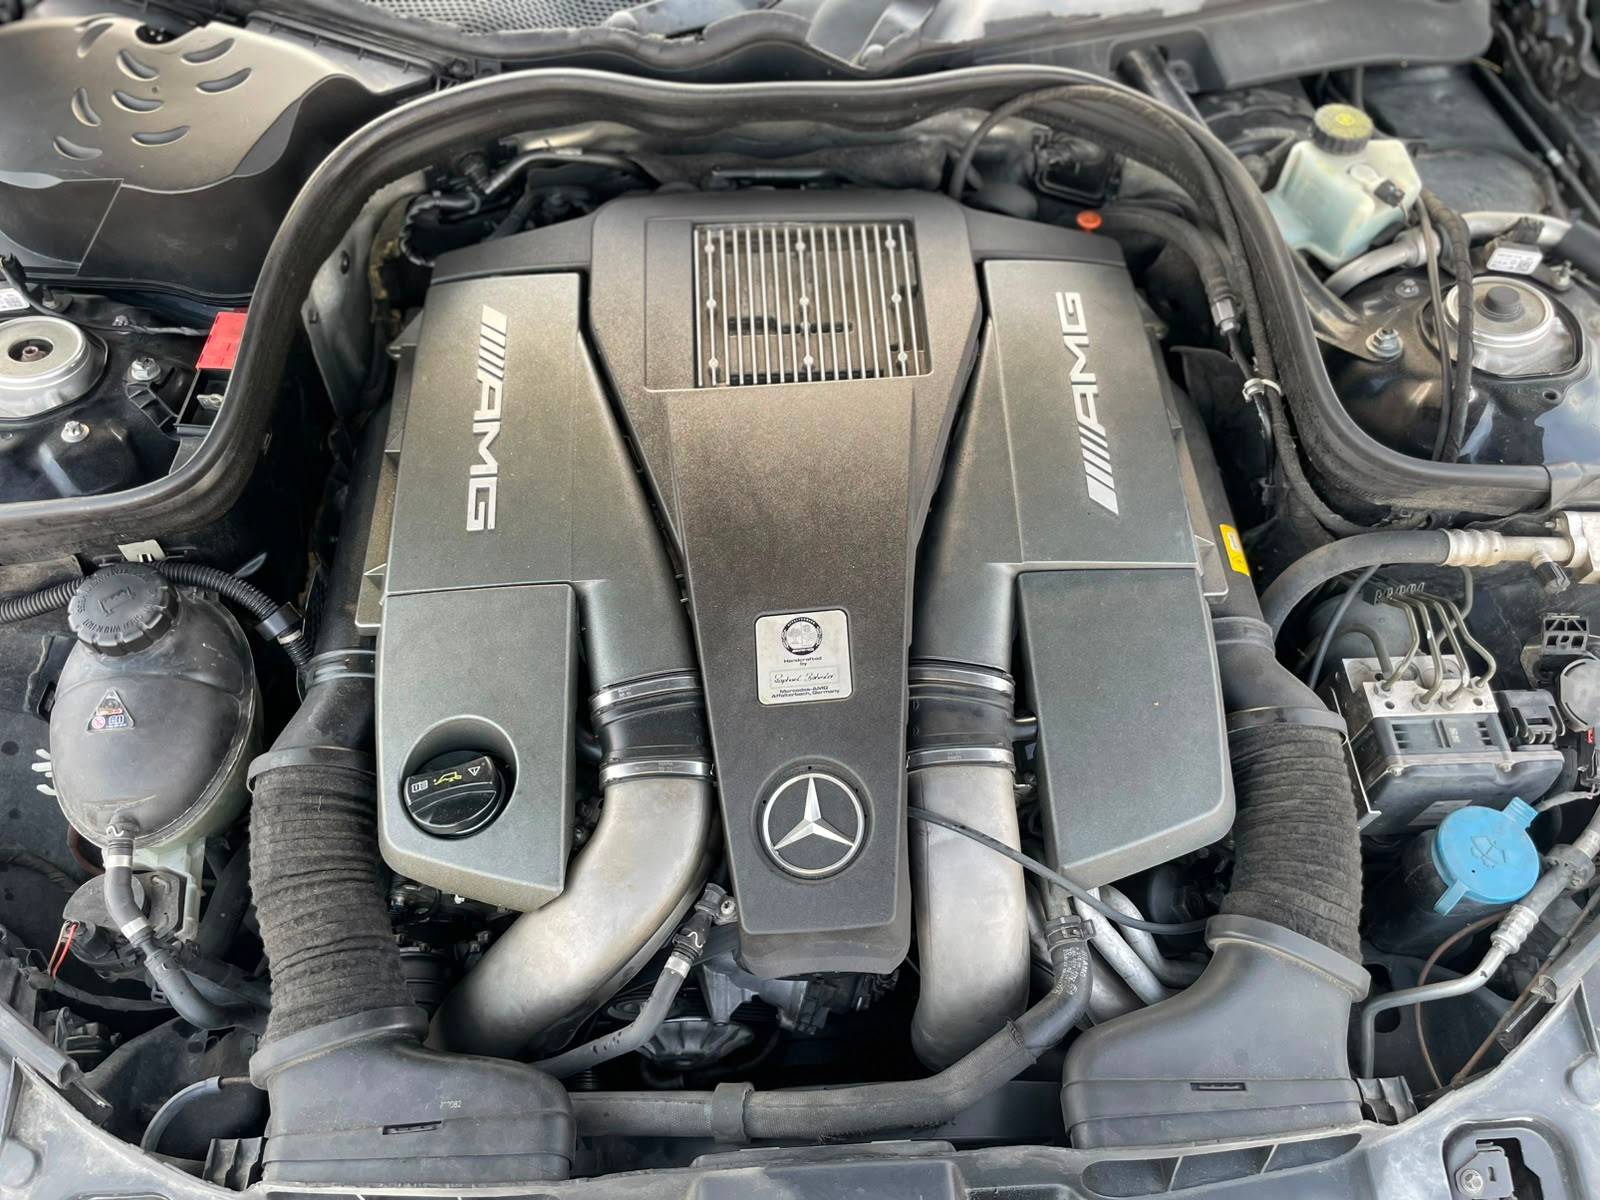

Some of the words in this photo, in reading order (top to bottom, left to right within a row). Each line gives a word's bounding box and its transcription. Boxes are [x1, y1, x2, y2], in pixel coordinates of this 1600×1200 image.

[1056, 291, 1106, 437] AMG
[466, 367, 503, 532] AMG
[779, 685, 829, 694] Mercedes-AMG
